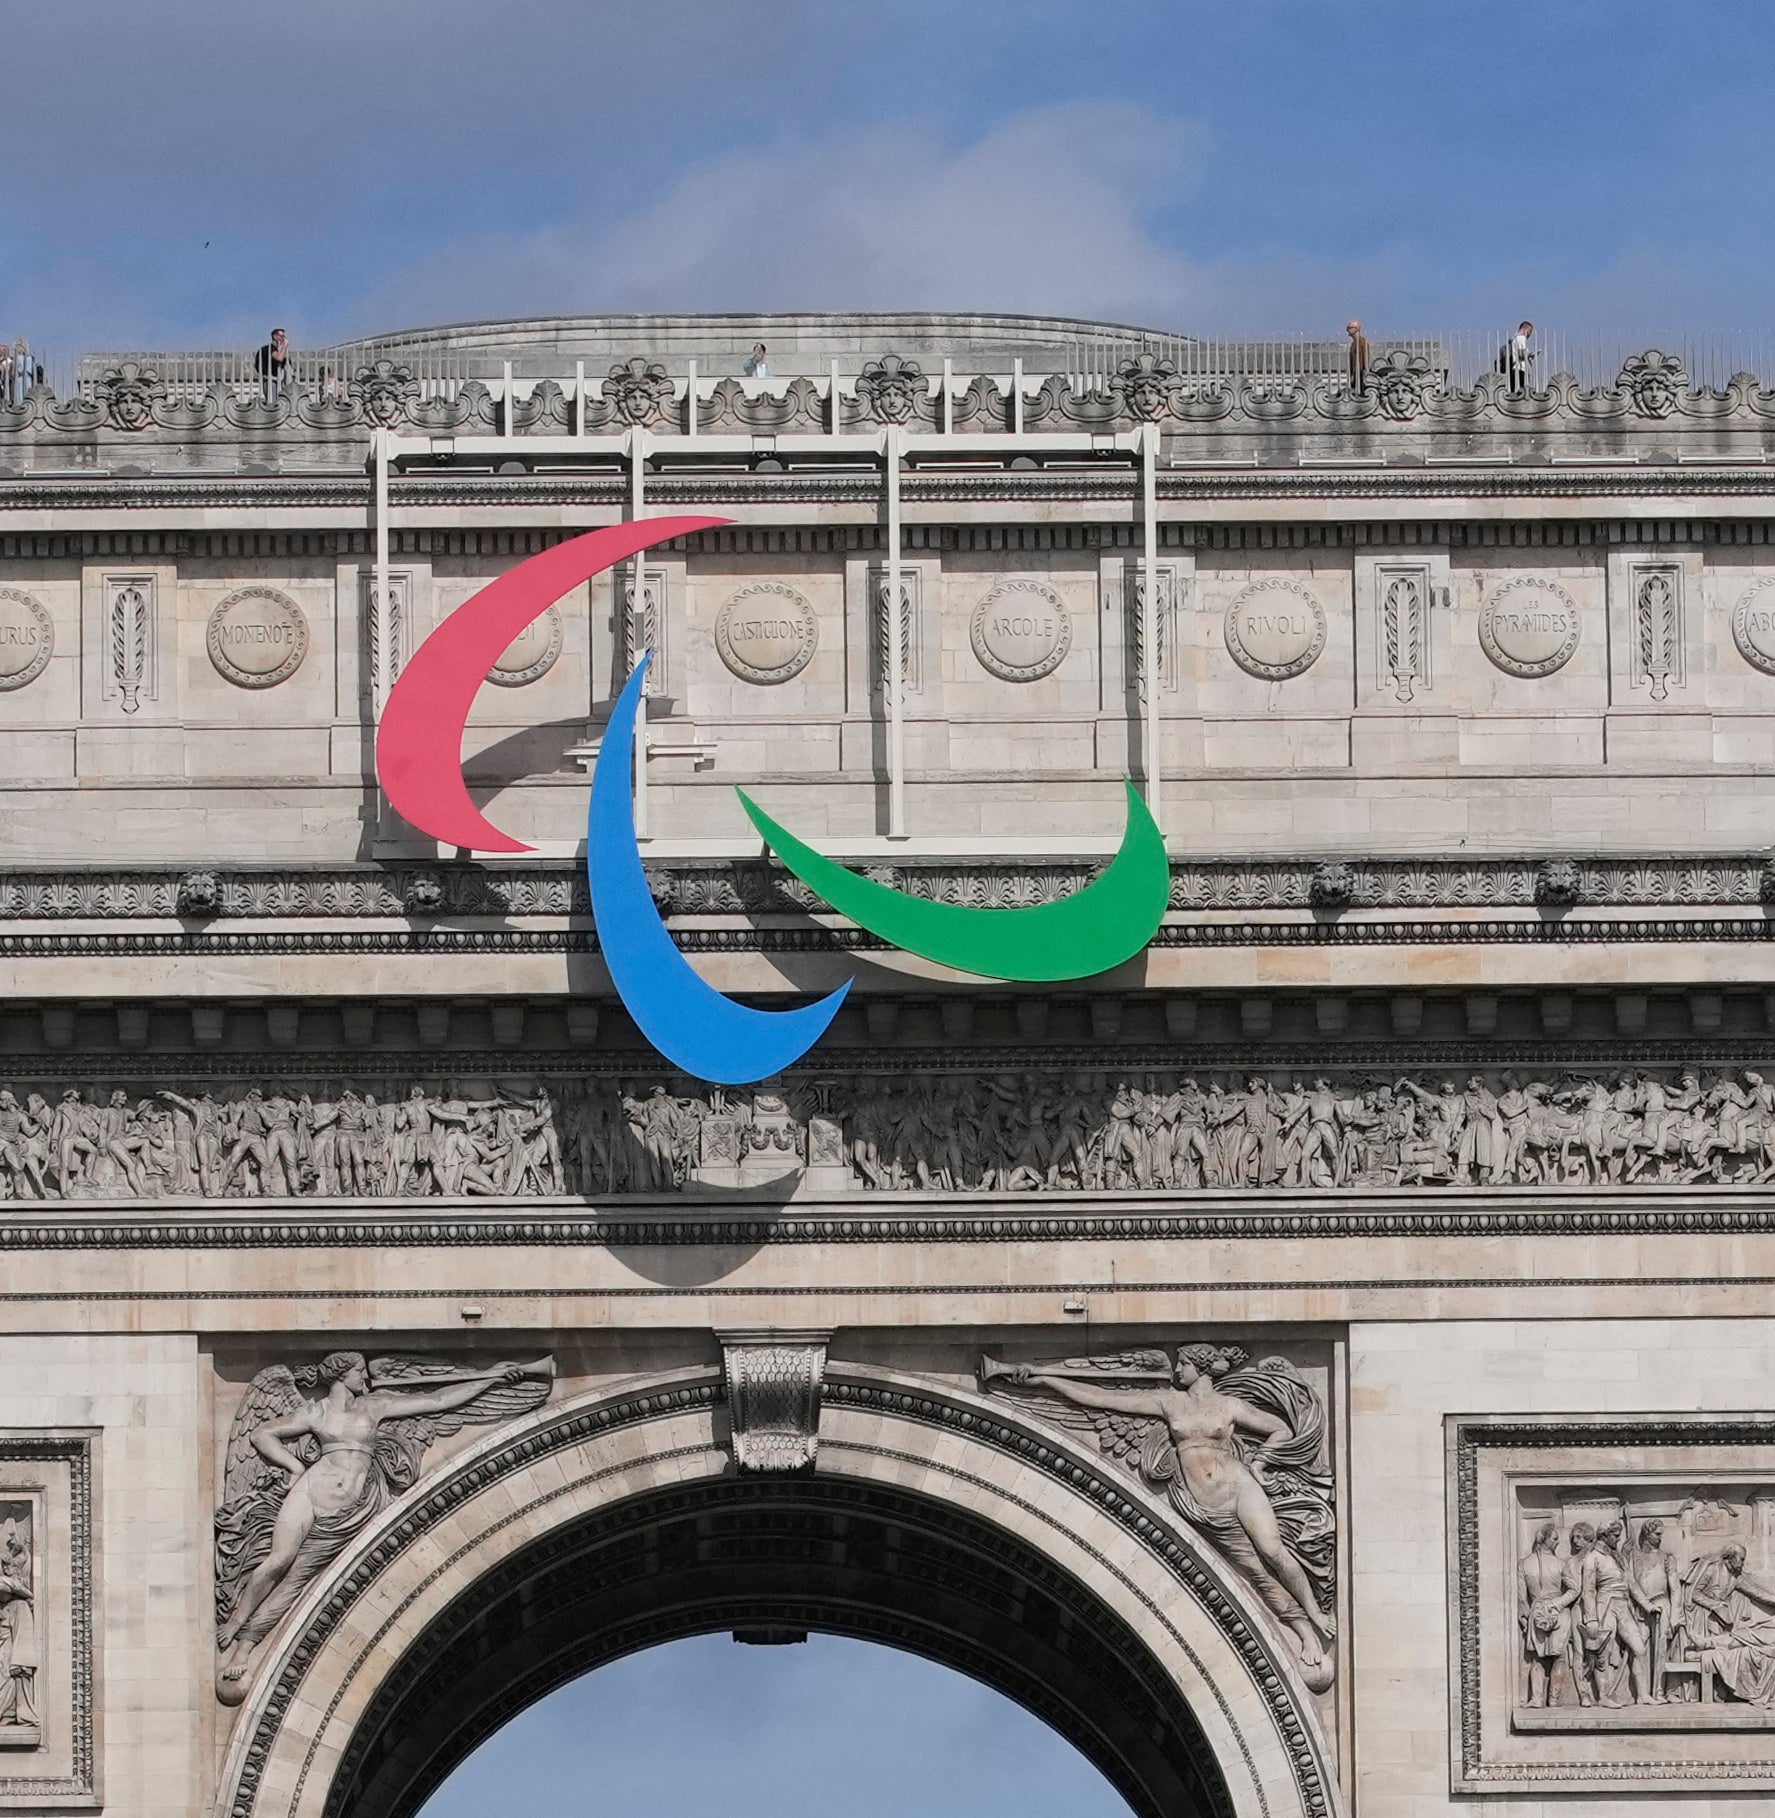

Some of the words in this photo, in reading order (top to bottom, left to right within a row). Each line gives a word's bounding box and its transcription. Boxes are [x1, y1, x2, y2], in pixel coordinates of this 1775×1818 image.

[993, 617, 1053, 637] ARCOLE
[1246, 615, 1306, 635] RIVOLI
[1493, 613, 1567, 633] PYRAMIDES
